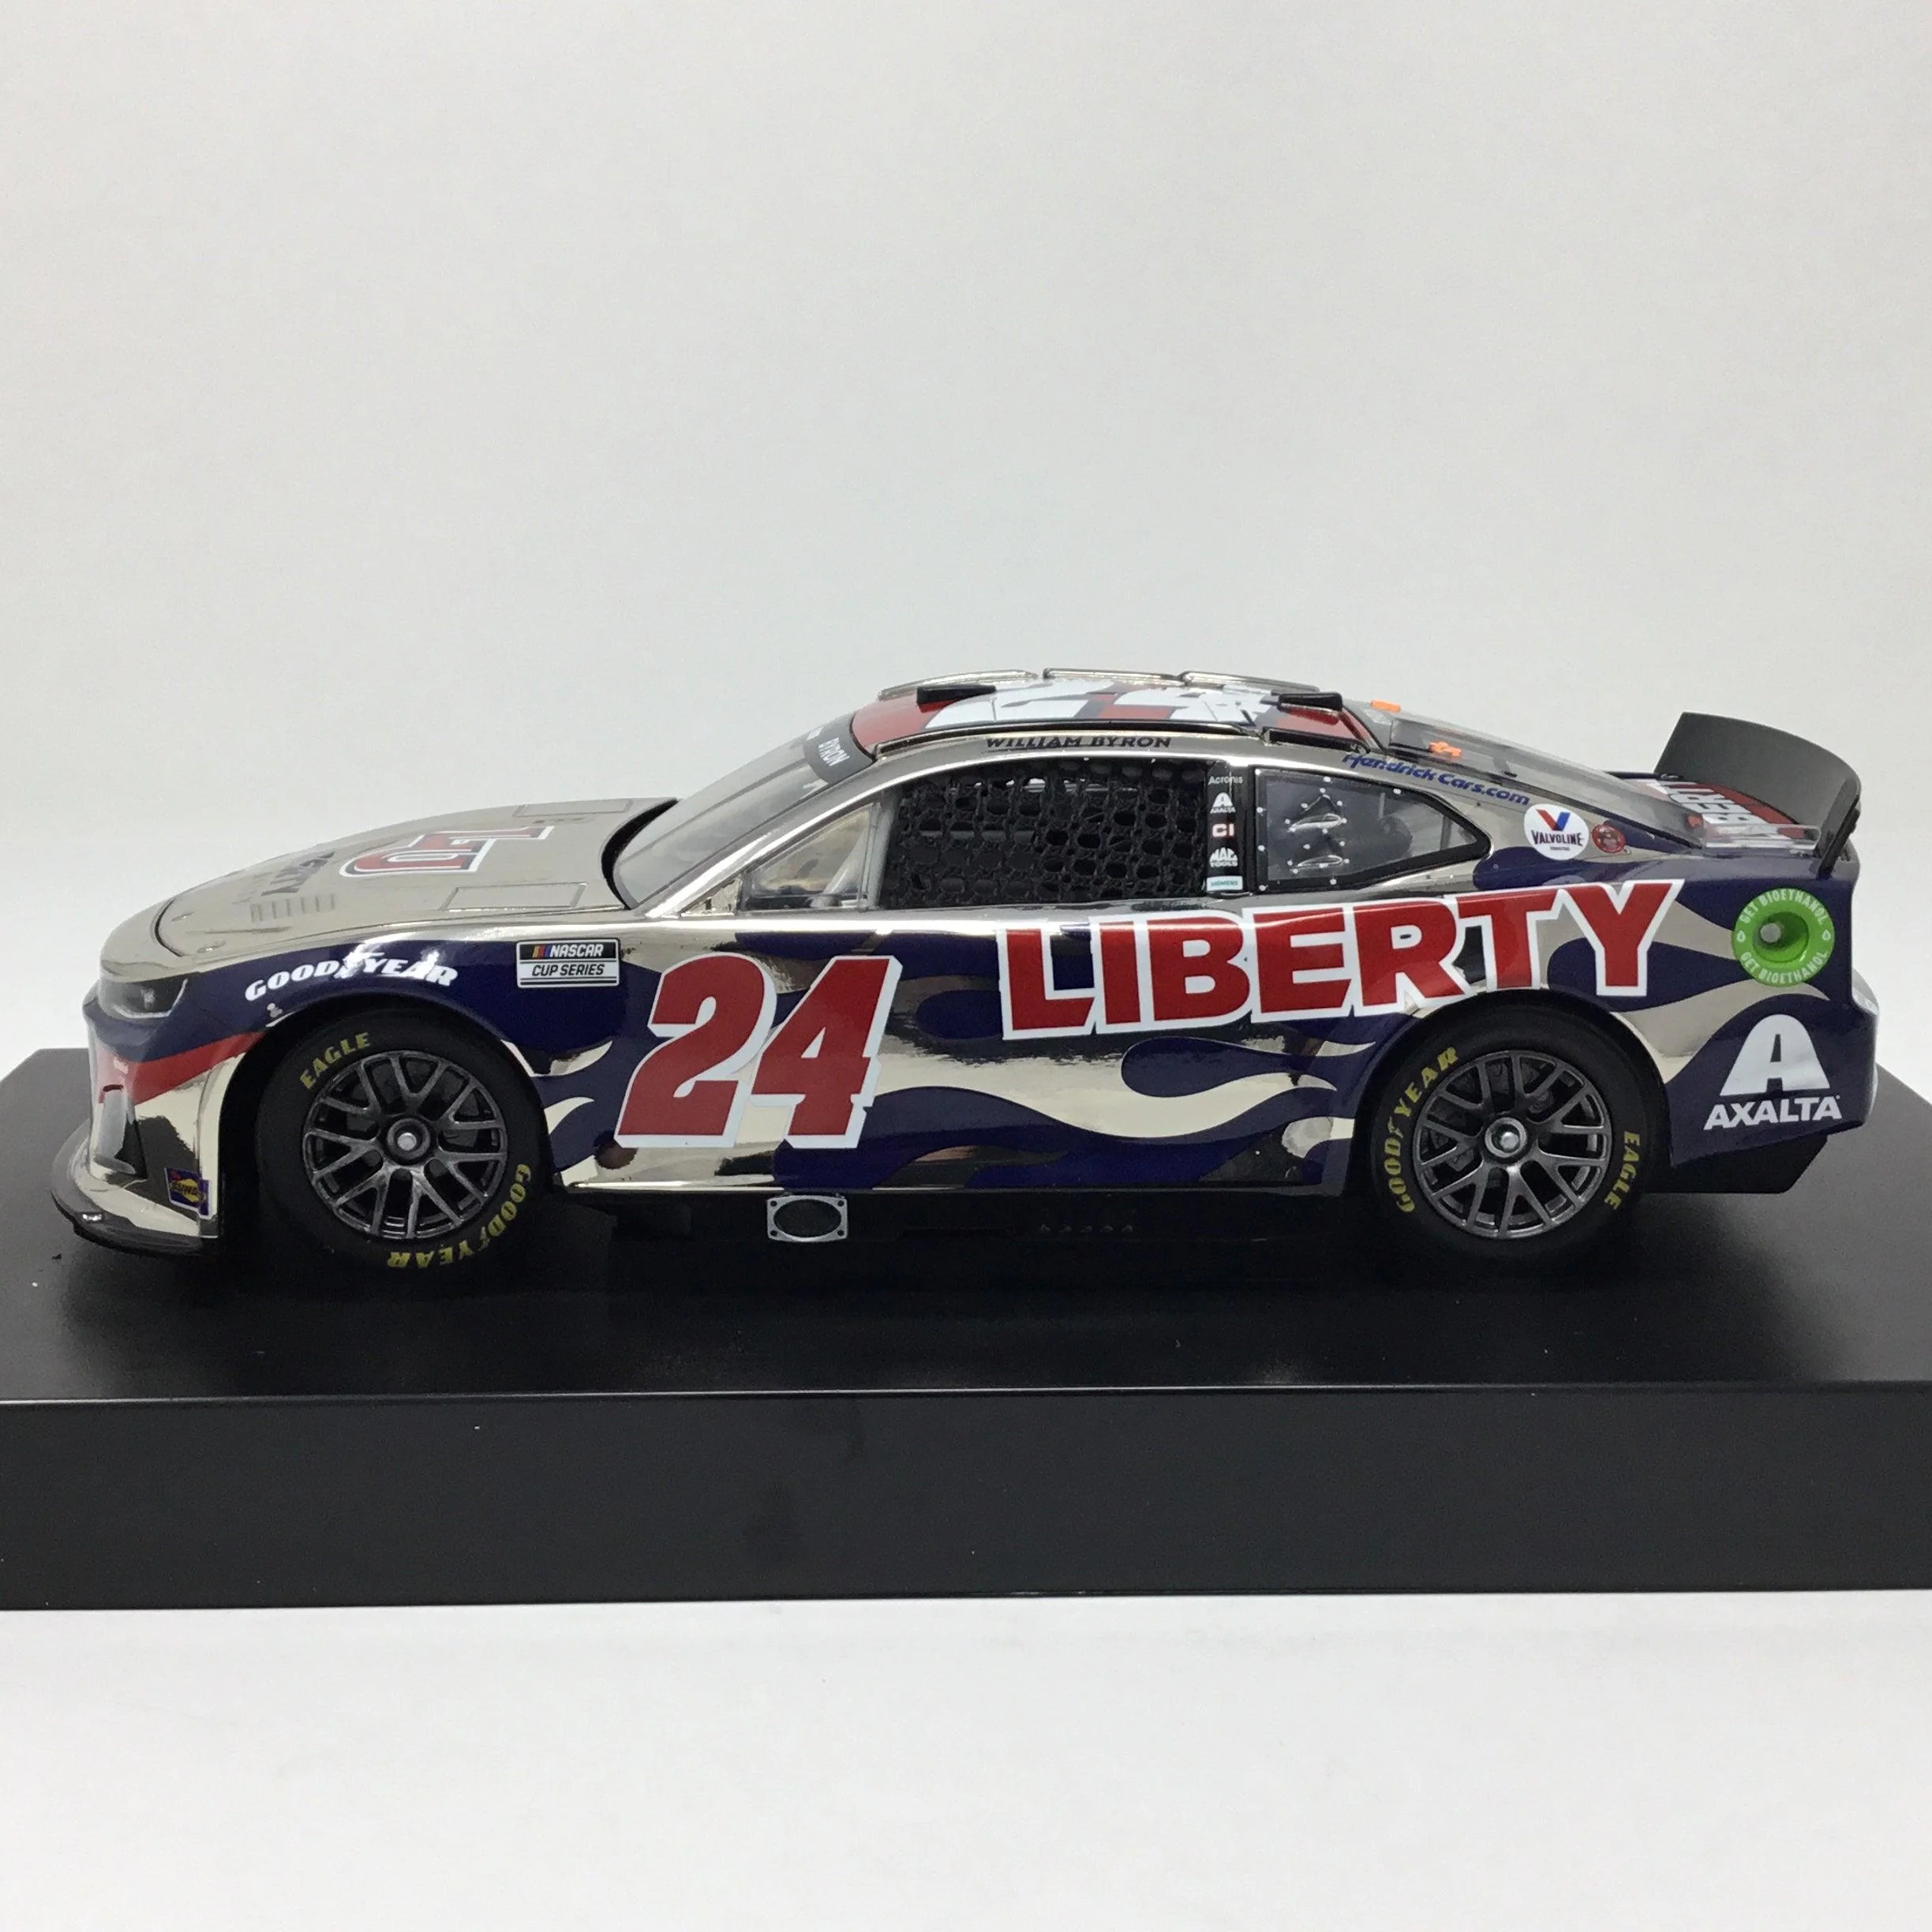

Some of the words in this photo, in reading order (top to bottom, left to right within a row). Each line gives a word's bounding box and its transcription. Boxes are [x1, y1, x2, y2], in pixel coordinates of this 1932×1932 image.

[818, 737, 851, 767] BYRON
[987, 737, 1082, 748] WILLIAM
[1090, 736, 1171, 748] BYRON
[1208, 776, 1243, 785] Acronis
[1531, 830, 1583, 847] VALVOLINE
[1739, 901, 1758, 923] GET
[549, 944, 604, 957] NASCAR
[997, 878, 1685, 1040] LIBERTY
[531, 964, 558, 976] CUP
[560, 964, 605, 976] SERIES
[299, 1032, 371, 1089] EAGLE
[614, 952, 903, 1149] 24
[1703, 1096, 1843, 1130] AXALTA
[1604, 1131, 1640, 1210] EAGLE
